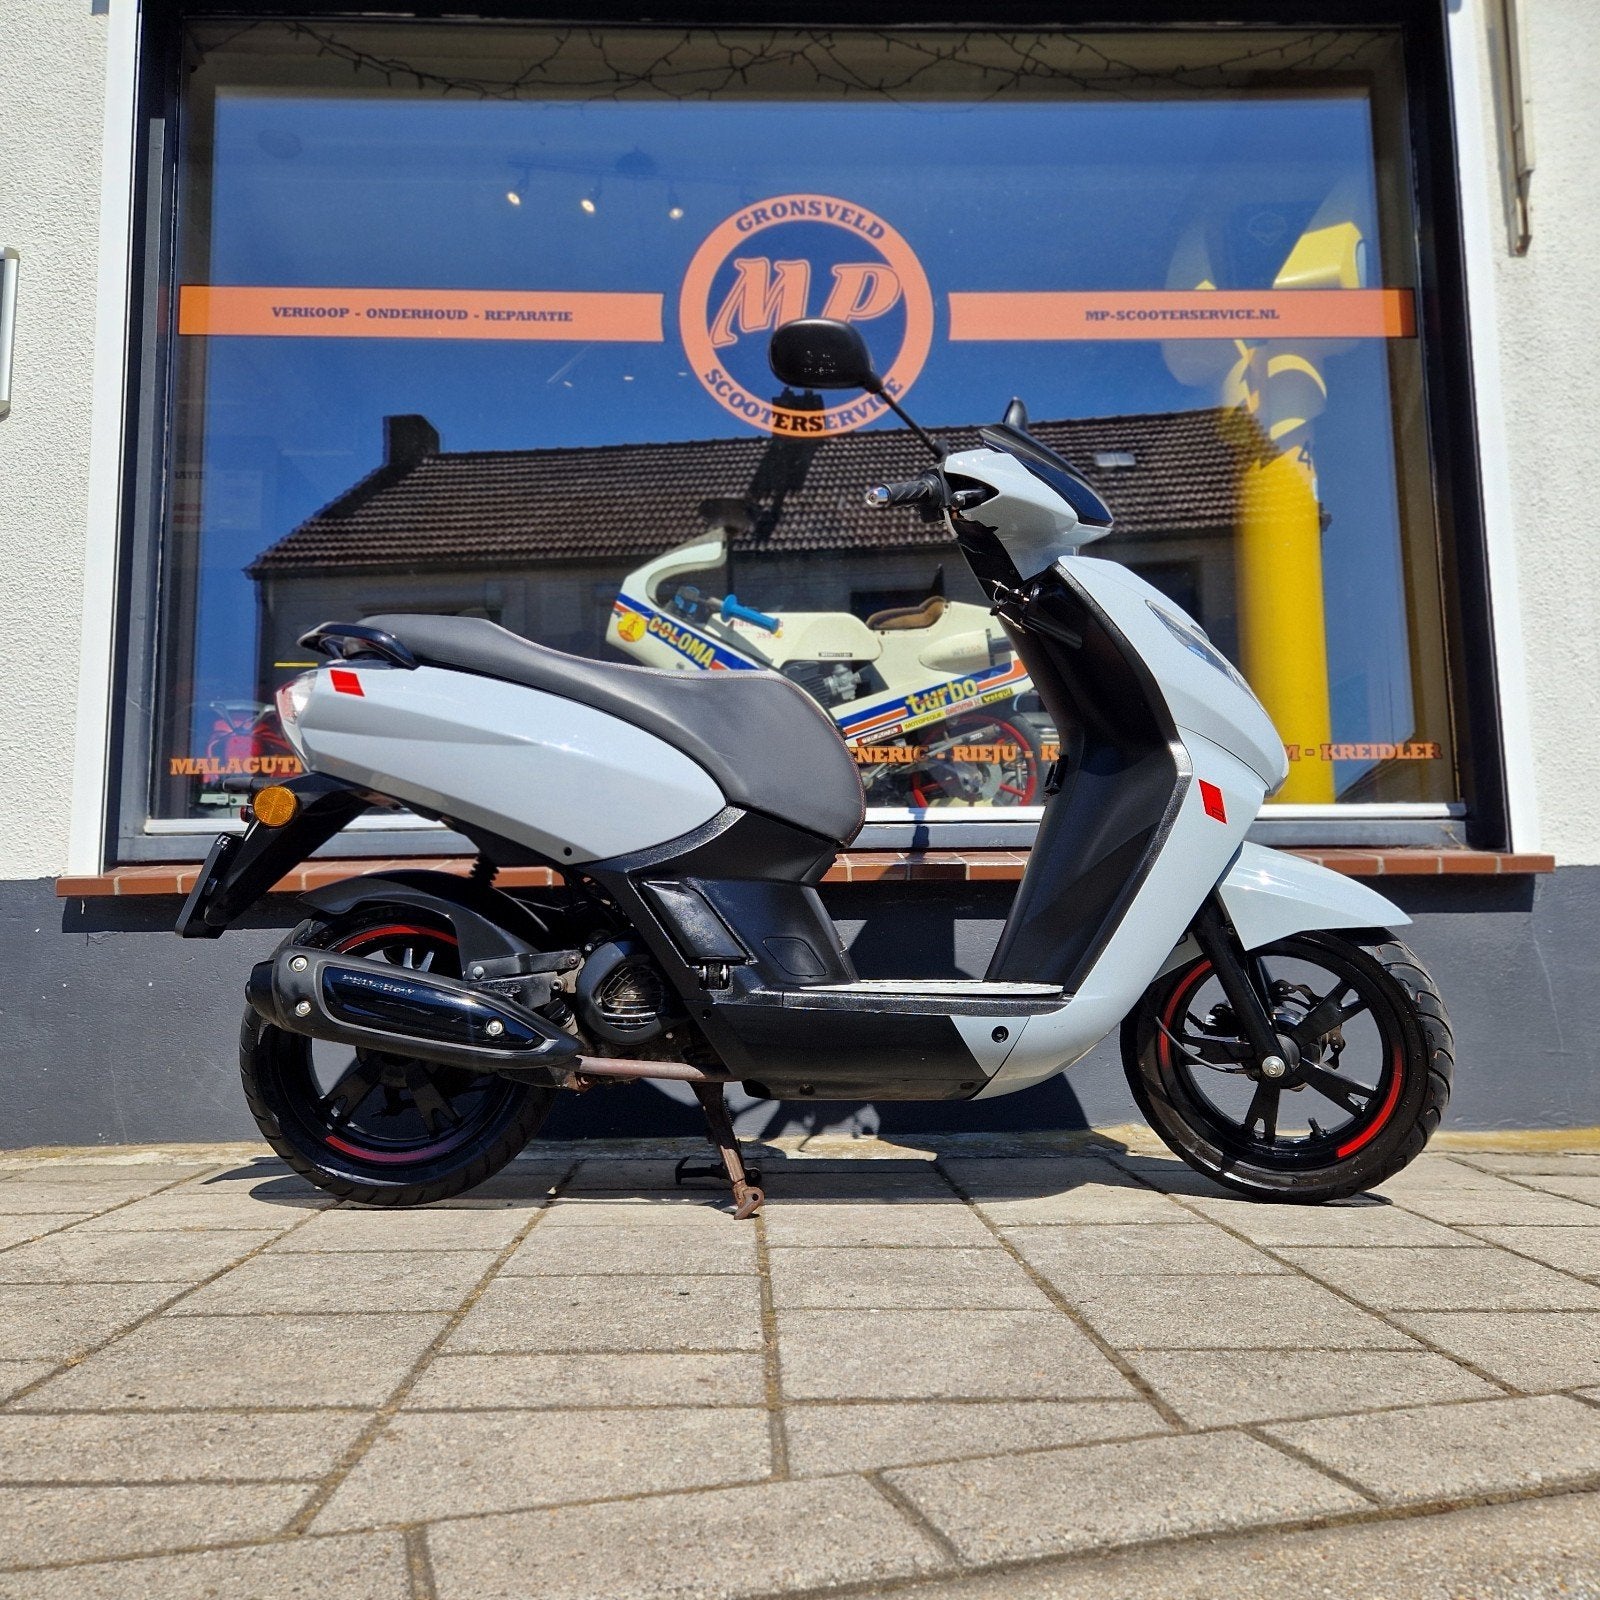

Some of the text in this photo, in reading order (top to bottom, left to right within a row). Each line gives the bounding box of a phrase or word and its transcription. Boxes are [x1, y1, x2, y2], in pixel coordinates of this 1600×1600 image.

[735, 200, 886, 240] GRONSVELD
[272, 306, 350, 318] VERKOOP
[366, 308, 468, 320] ONDERHOUD
[484, 310, 573, 322] REPARATIE
[1085, 309, 1280, 322] MP-SCOOTERSERVICE.NL
[648, 613, 716, 669] COLOMA
[905, 679, 978, 715] turbo
[170, 756, 303, 775] MALAGUTI
[952, 745, 1018, 764] RIEJU
[1320, 743, 1441, 761] KREIDLER
